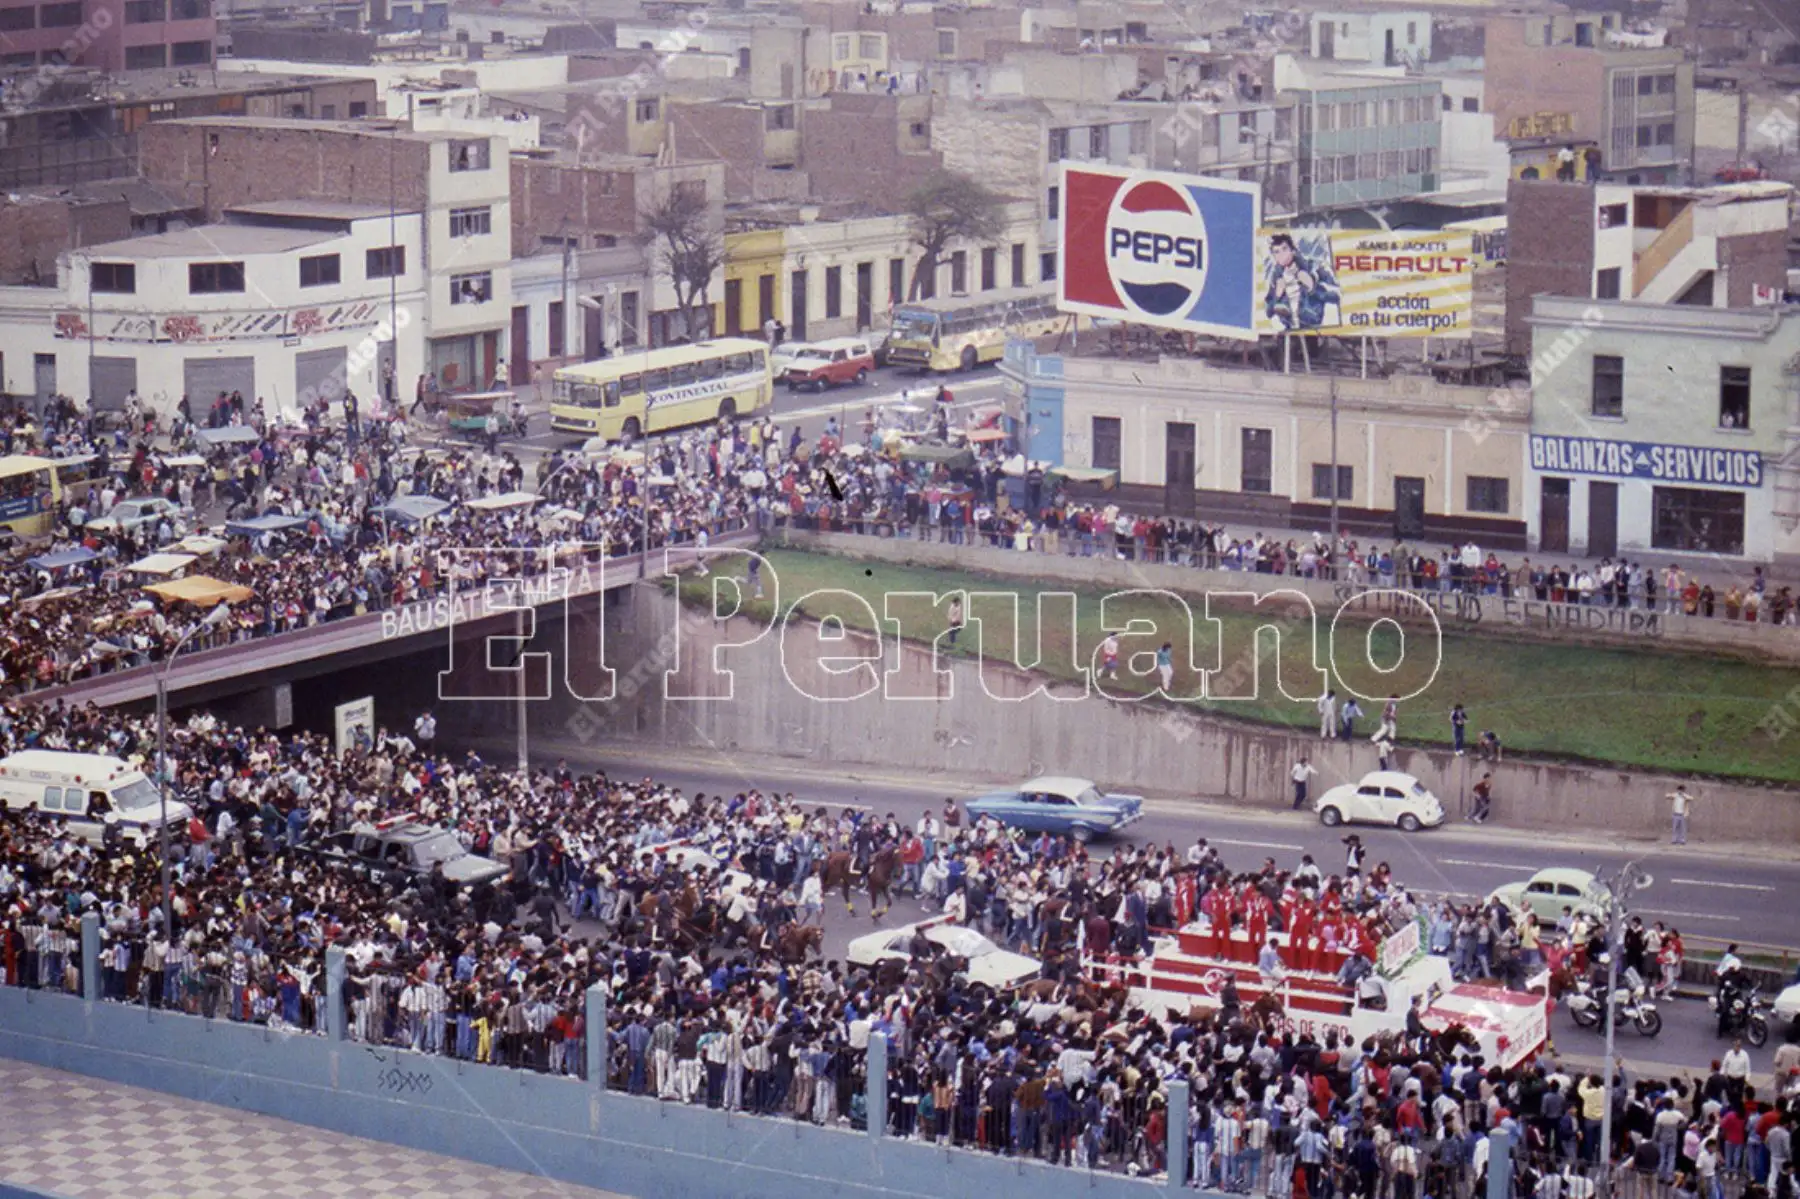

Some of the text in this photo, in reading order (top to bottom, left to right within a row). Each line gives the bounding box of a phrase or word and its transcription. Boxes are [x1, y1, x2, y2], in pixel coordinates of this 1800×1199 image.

[1111, 227, 1202, 270] PEPSI
[1356, 240, 1388, 251] JEANS
[1401, 240, 1448, 252] JACKETS
[1334, 254, 1469, 274] RENAULT
[1377, 292, 1430, 311] acción
[1350, 308, 1458, 333] en tu cuerpo!
[654, 382, 729, 402] CONTINENTAL
[1532, 436, 1761, 485] BALANZAS SERVICIOS
[381, 566, 594, 640] BAUSATE Y MEZA
